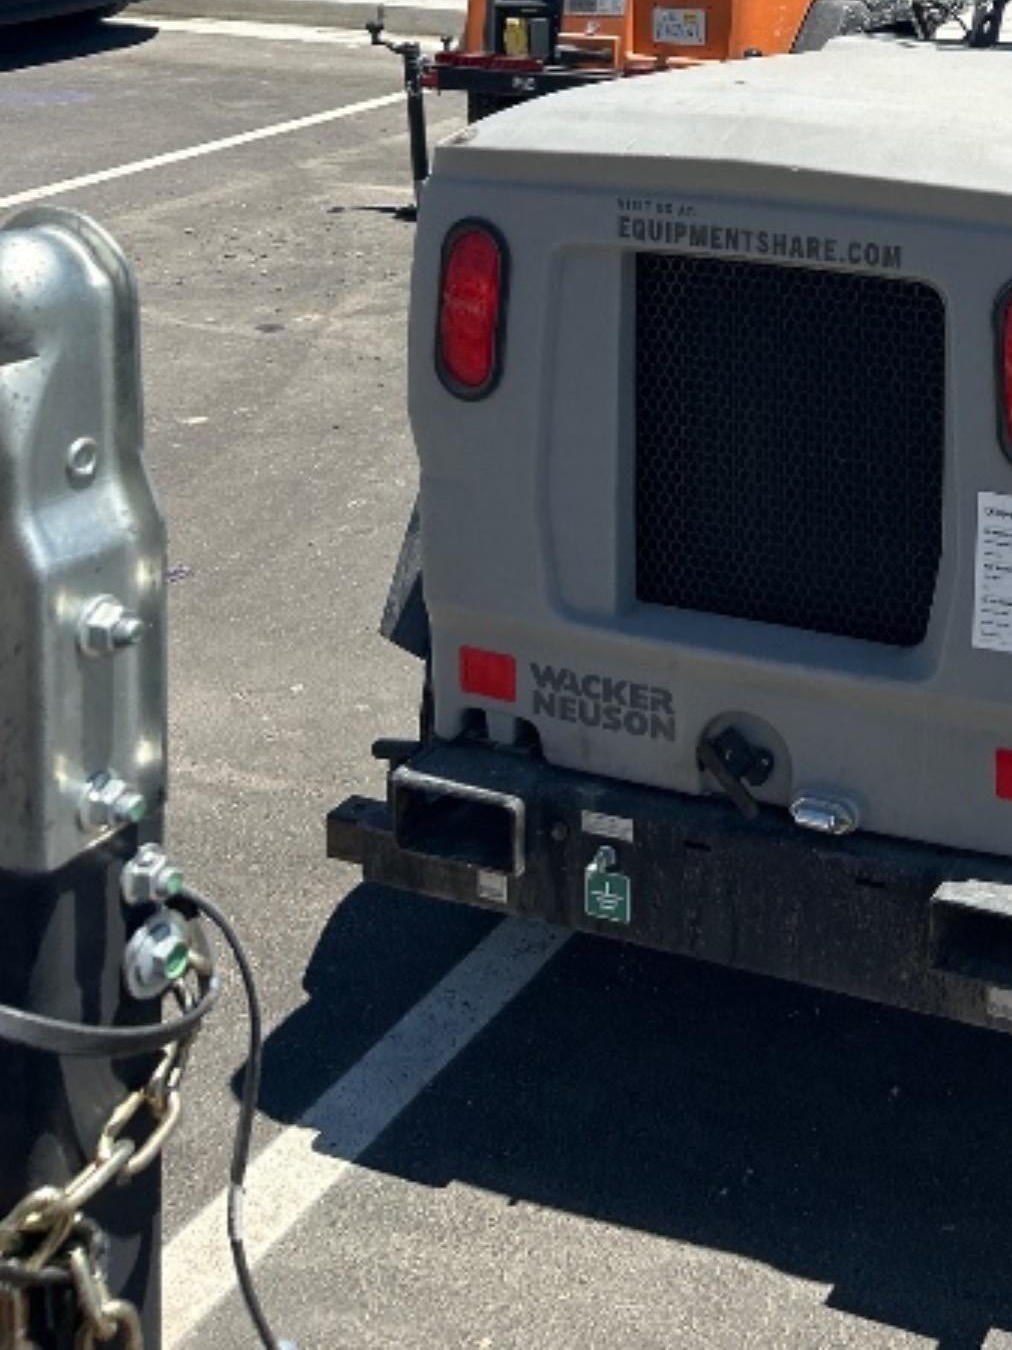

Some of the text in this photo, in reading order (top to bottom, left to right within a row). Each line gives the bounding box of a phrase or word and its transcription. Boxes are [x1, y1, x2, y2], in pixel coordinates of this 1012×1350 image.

[617, 215, 904, 269] EQUIPMENTSHARE.COM
[529, 661, 676, 715] WACKER
[531, 689, 677, 742] NEUSON
